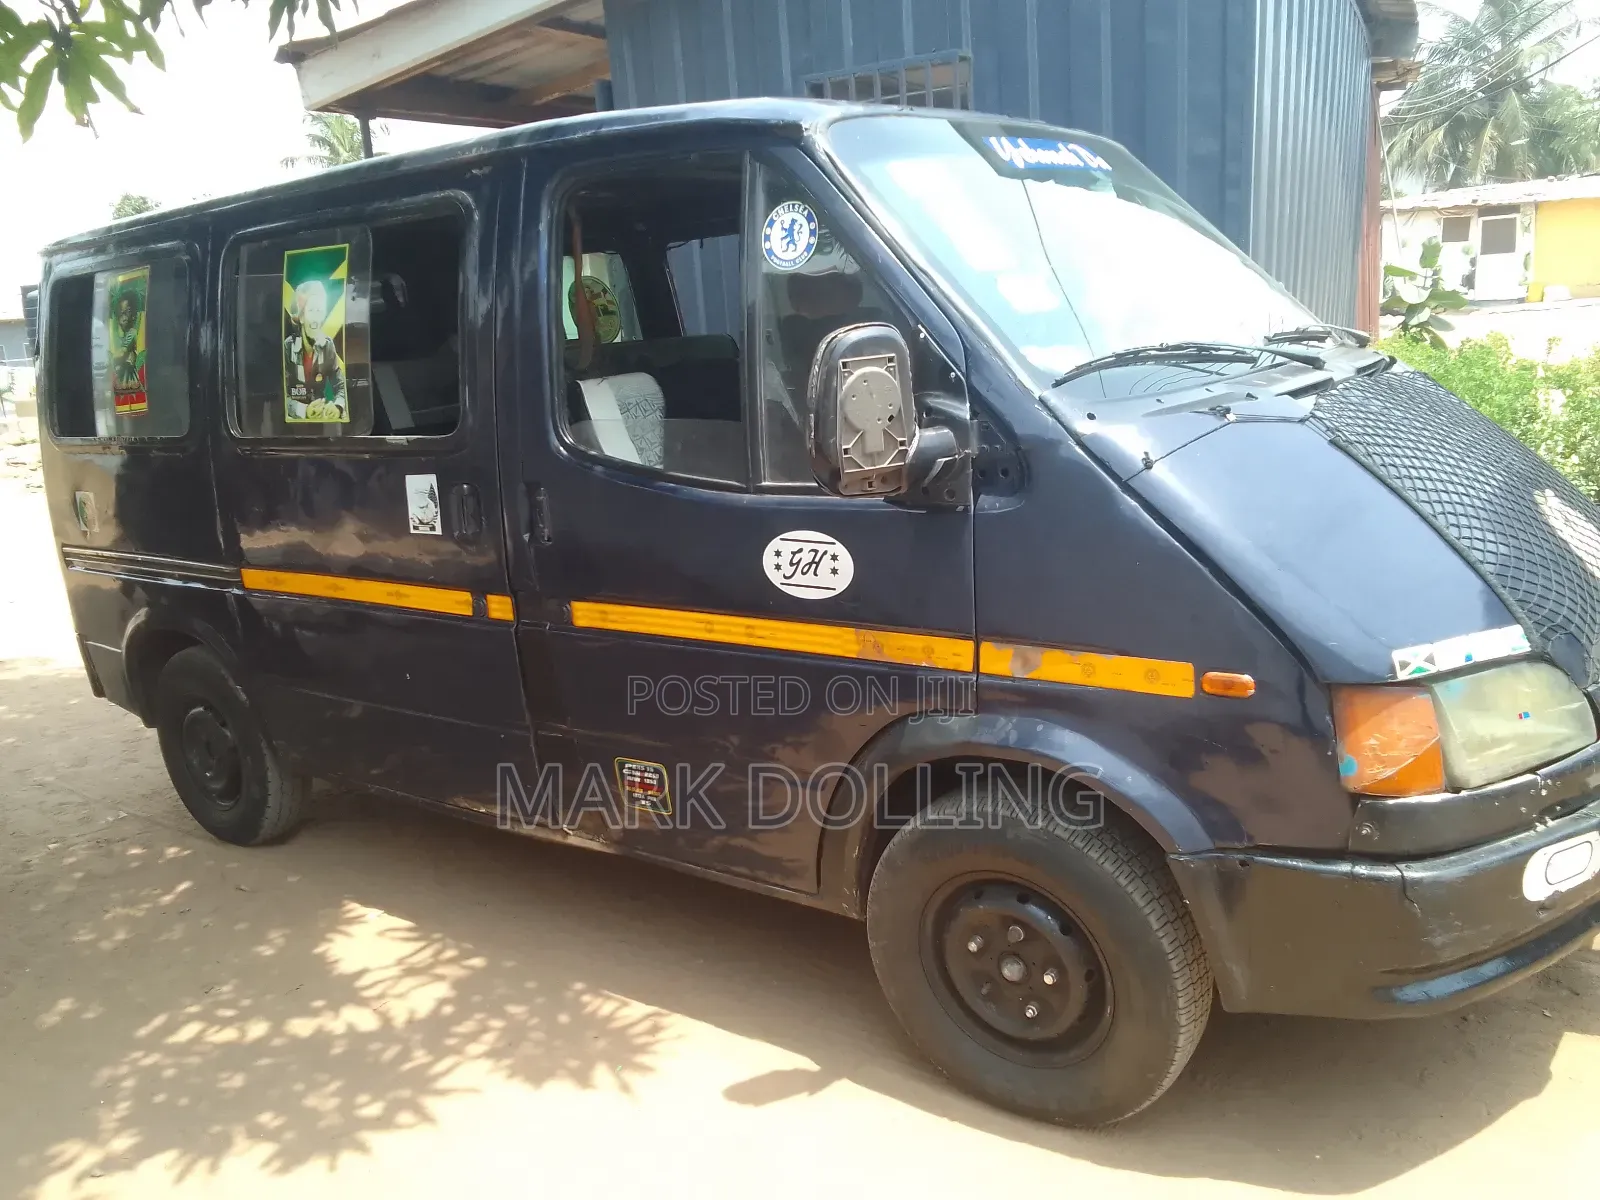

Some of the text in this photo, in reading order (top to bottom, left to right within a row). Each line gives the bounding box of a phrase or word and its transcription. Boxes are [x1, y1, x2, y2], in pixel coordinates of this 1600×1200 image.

[772, 204, 809, 221] CHELSEA
[290, 387, 307, 396] BOB
[783, 547, 828, 580] GH
